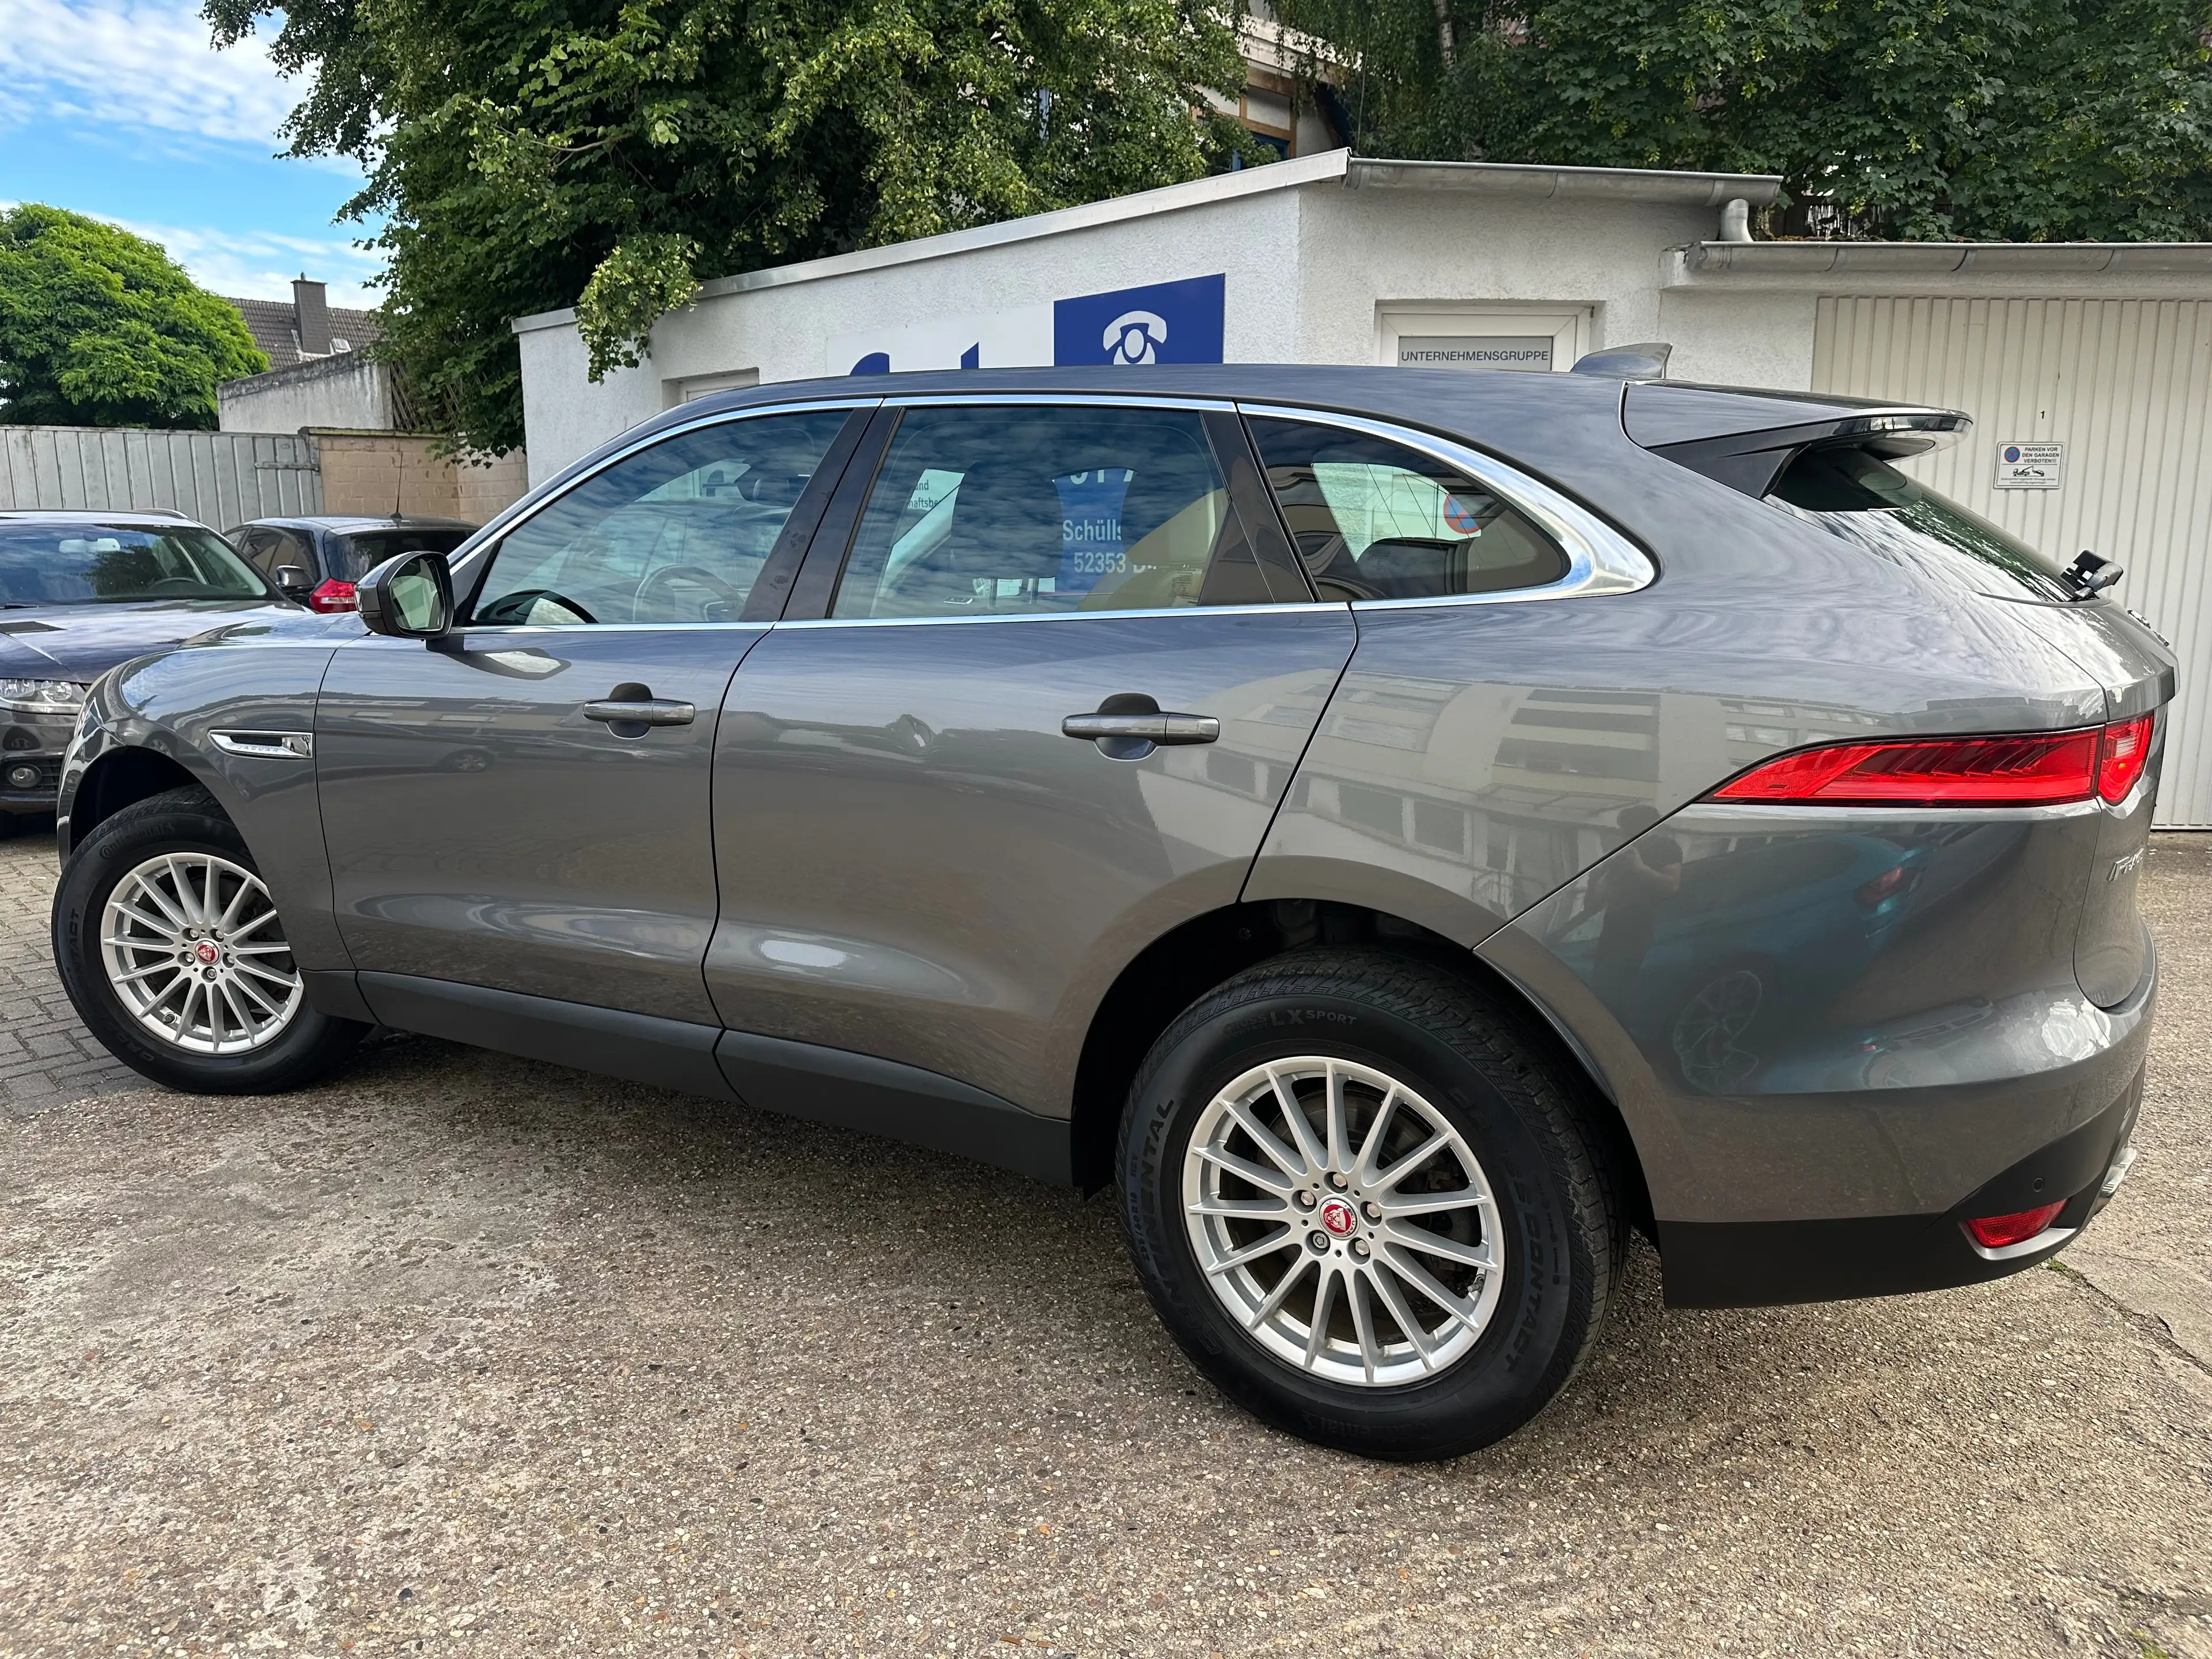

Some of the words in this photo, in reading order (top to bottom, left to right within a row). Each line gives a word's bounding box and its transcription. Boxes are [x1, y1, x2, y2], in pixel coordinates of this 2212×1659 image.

[1402, 350, 1549, 361] UNTERNEHMENSGRUPPE
[2040, 411, 2045, 419] 1
[1074, 552, 1127, 574] 52353
[237, 745, 279, 753] JAGUAR
[1269, 1009, 1305, 1027] LX
[1305, 1009, 1358, 1025] SPORT
